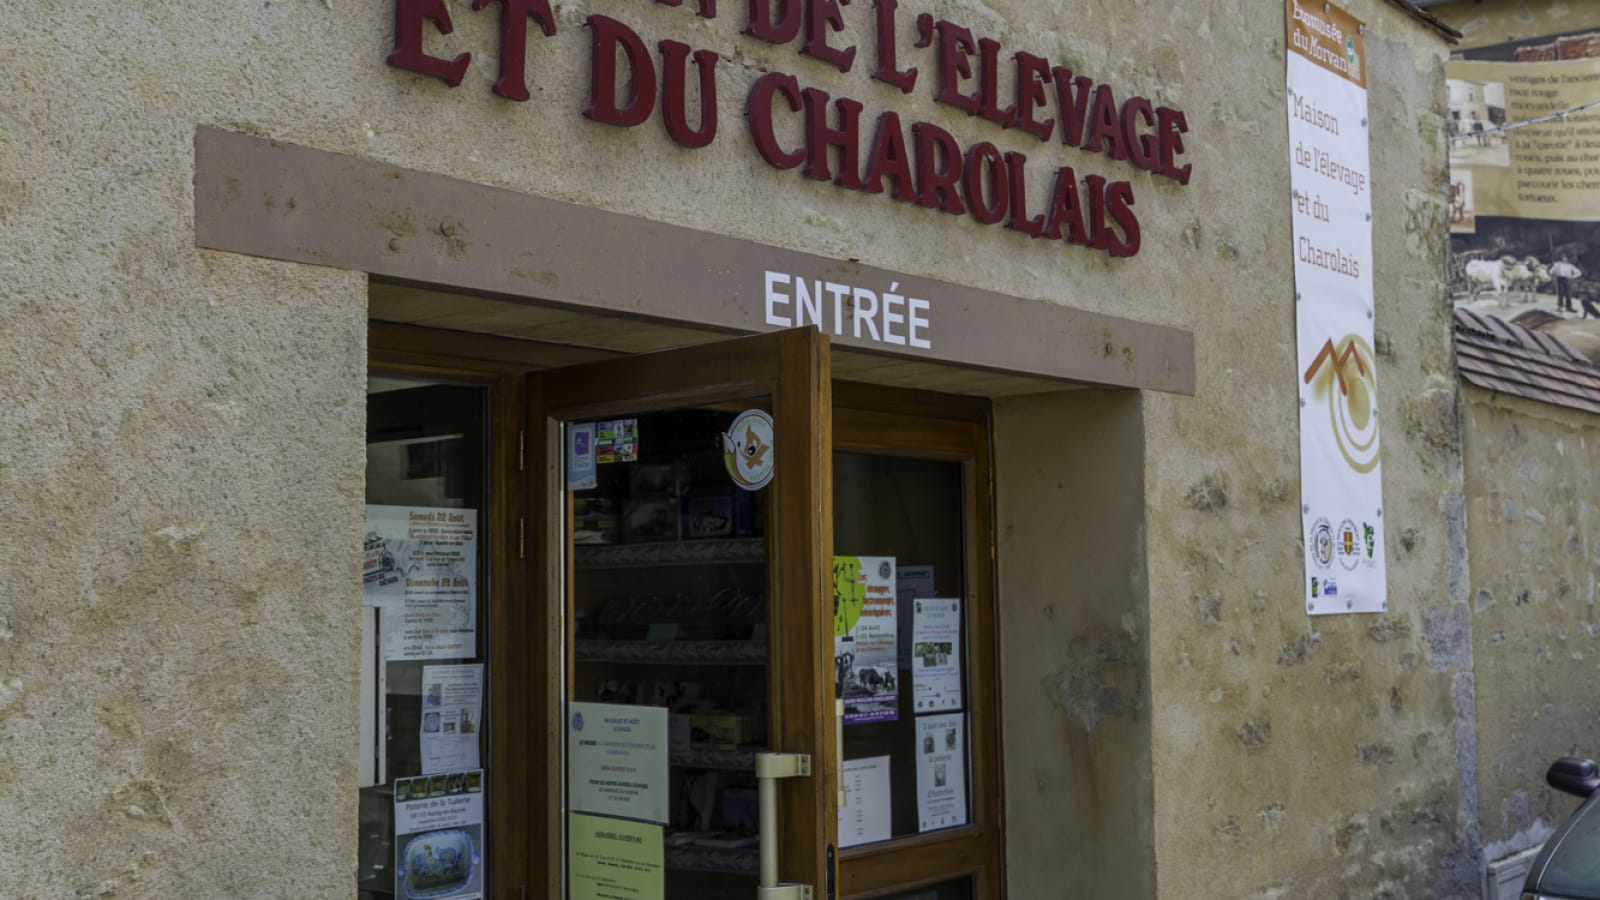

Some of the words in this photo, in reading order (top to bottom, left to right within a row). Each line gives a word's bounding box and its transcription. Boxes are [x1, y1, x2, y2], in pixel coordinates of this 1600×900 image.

[1293, 28, 1308, 52] du
[1309, 35, 1348, 73] Morvan
[871, 0, 1192, 185] L'ELEVAGE
[1293, 92, 1340, 136] Maison
[386, 0, 556, 102] ET
[582, 14, 720, 148] DU
[747, 72, 1141, 257] CHAROLAIS
[1295, 141, 1311, 169] de
[1314, 147, 1365, 195] l'élevage
[1297, 191, 1310, 215] et
[1313, 195, 1329, 223] du
[1299, 236, 1360, 278] Charolais
[765, 270, 931, 349] ENTRÉE
